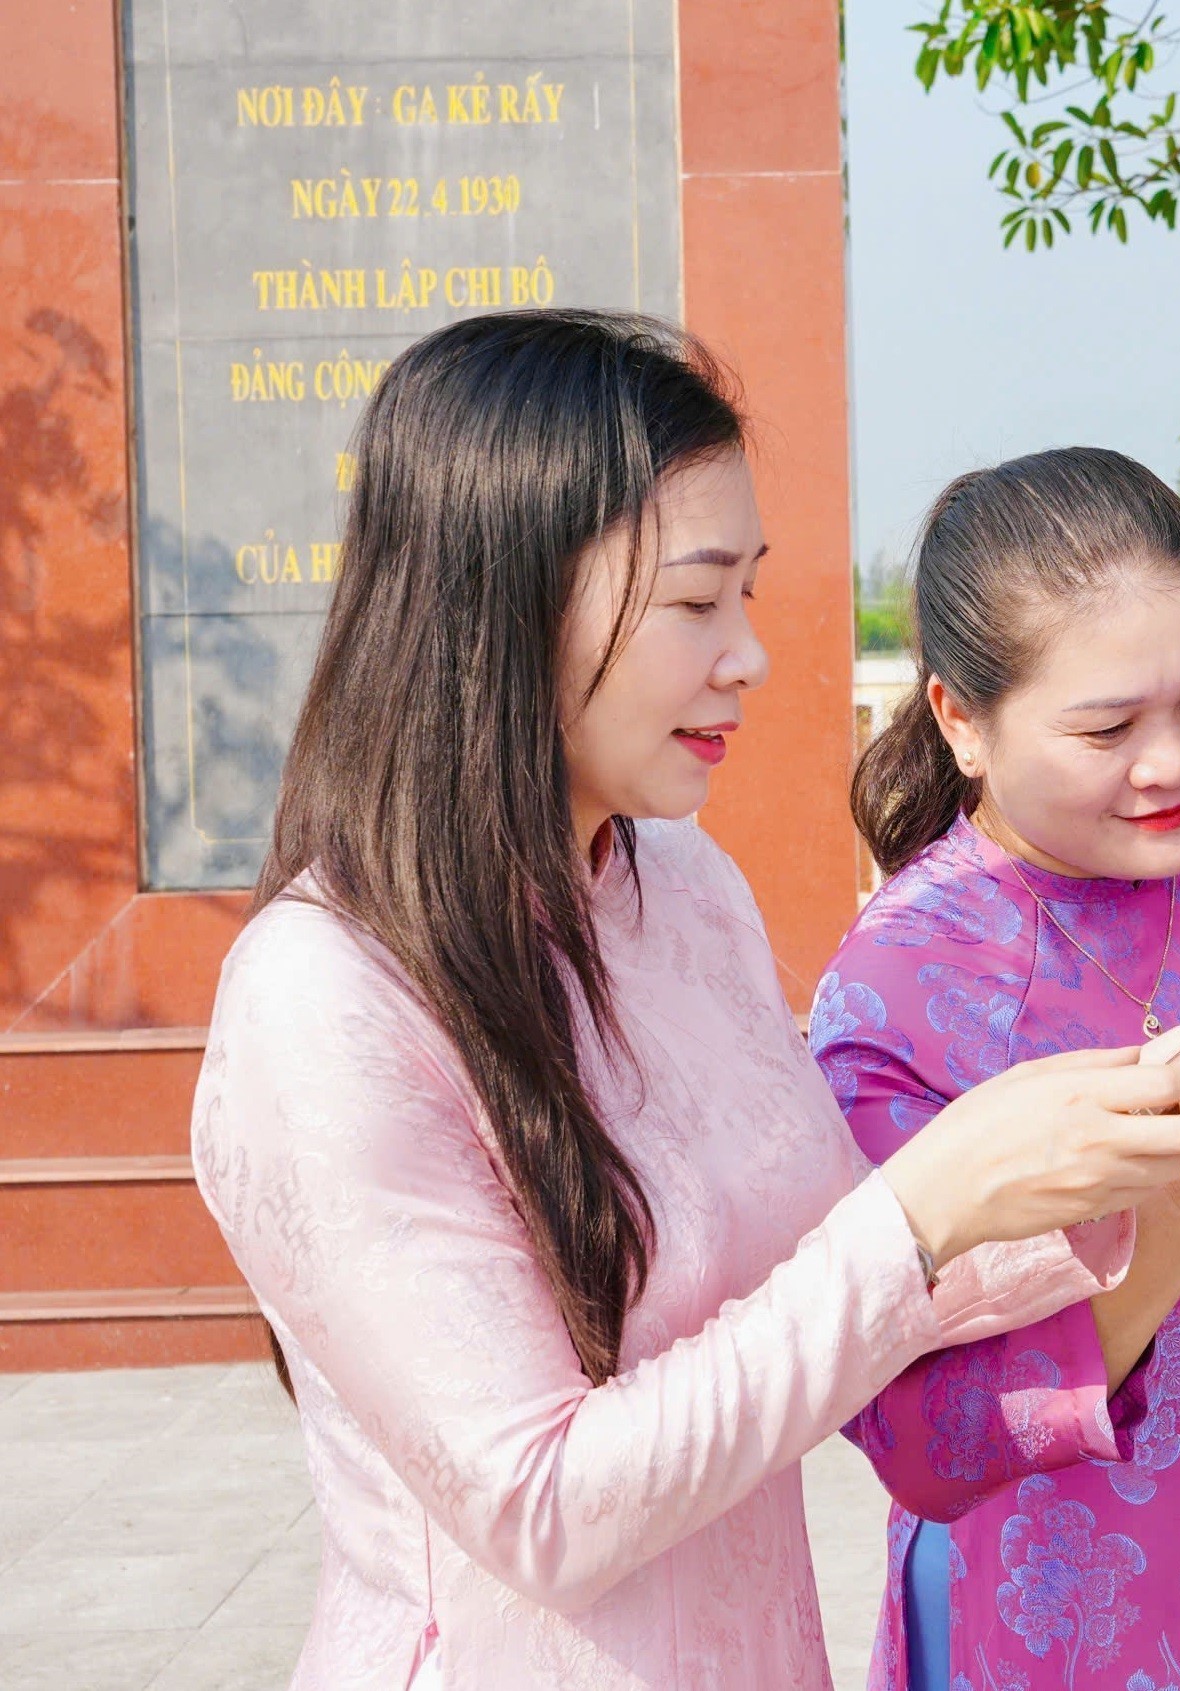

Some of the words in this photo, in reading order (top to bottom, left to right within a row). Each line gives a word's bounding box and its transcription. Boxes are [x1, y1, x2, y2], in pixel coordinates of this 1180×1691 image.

[237, 85, 294, 127] NƠI
[302, 76, 367, 126] ĐÂY
[392, 85, 438, 124] GA
[499, 74, 564, 124] RẤY
[291, 168, 382, 218] NGÀY
[252, 260, 367, 311] THÀNH
[375, 258, 438, 313] LẬP
[443, 266, 502, 307] CHI
[510, 255, 555, 312] BỘ
[230, 347, 306, 401] ĐẢNG
[236, 531, 302, 584] CỦA
